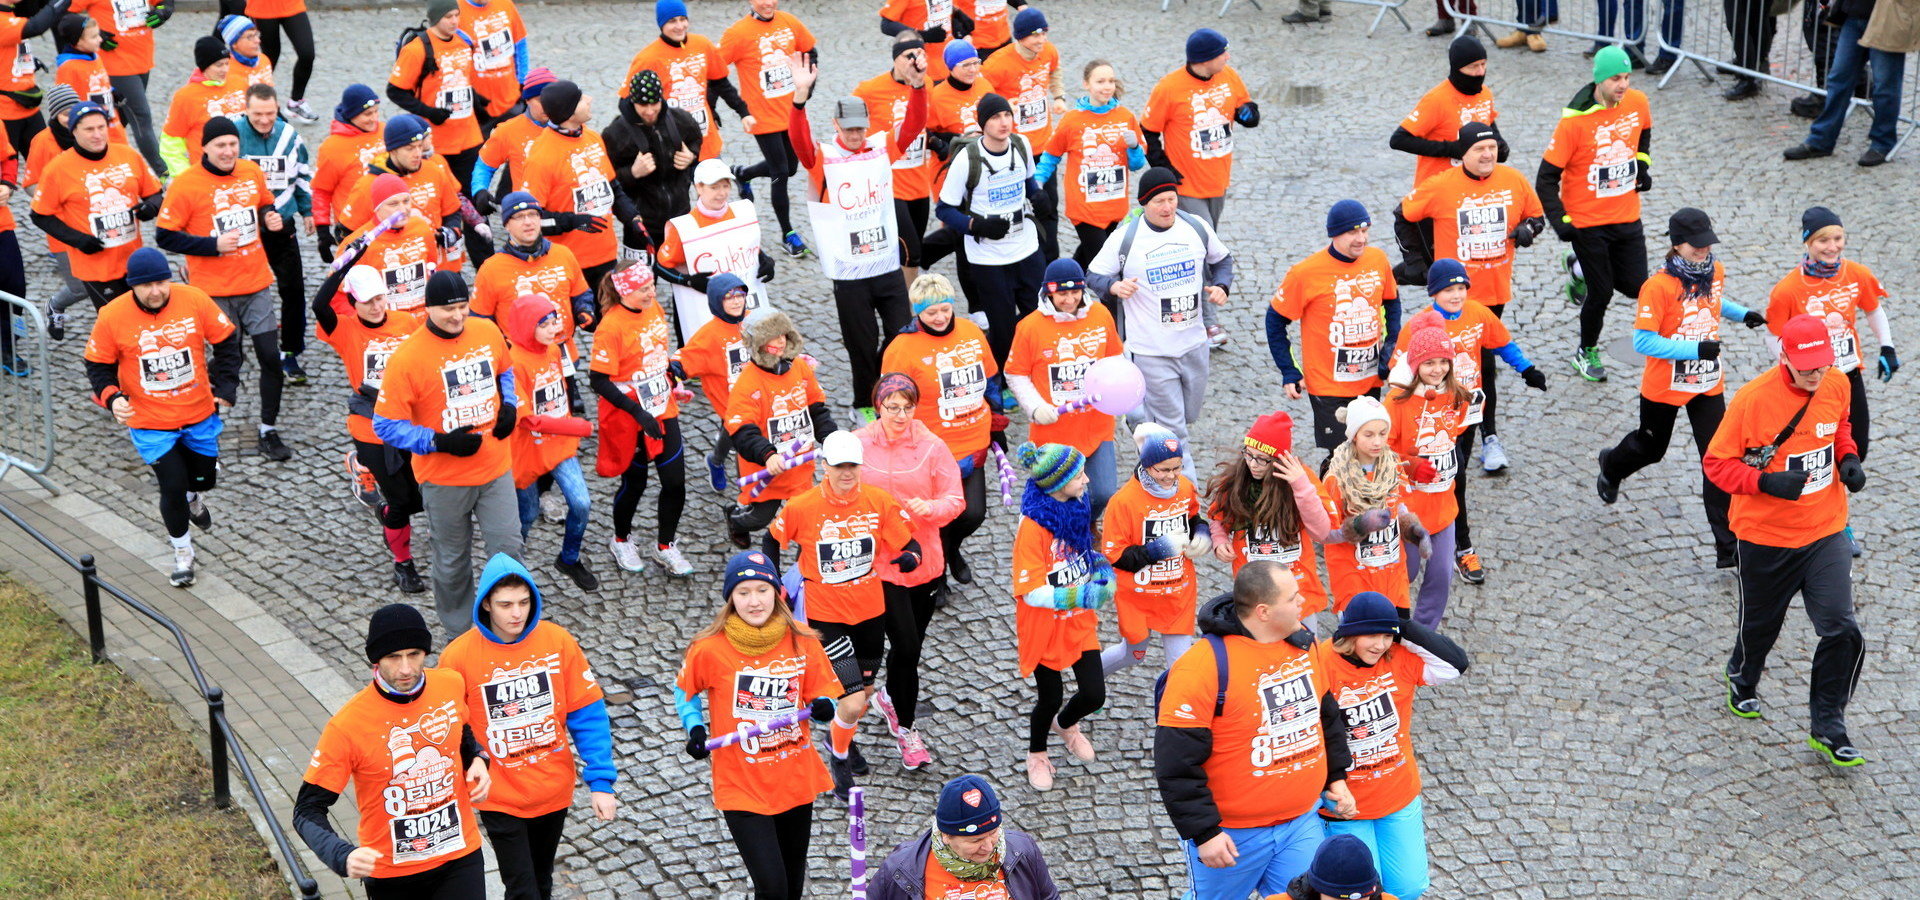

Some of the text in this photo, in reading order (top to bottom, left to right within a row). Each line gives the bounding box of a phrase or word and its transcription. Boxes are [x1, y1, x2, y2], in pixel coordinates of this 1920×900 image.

[1608, 164, 1629, 179] 923
[101, 211, 131, 230] 1069
[1465, 207, 1498, 225] 1580
[1161, 263, 1184, 274] NOVA
[1184, 260, 1195, 270] BP
[1151, 276, 1196, 291] LEGIONOWO
[1170, 296, 1195, 313] 586
[1329, 322, 1345, 346] 8
[147, 351, 185, 373] 3453
[456, 363, 484, 385] 832
[951, 366, 977, 386] 4817
[777, 411, 806, 433] 4821
[1815, 422, 1824, 438] 8
[1801, 450, 1826, 471] 150
[830, 541, 860, 560] 266
[496, 676, 540, 703] 4798
[748, 677, 787, 697] 4712
[1346, 698, 1385, 726] 3411
[486, 724, 508, 759] 8
[1250, 735, 1273, 767] 8
[383, 786, 407, 816] 8
[406, 772, 454, 801] BIEG
[404, 808, 451, 838] 3024
